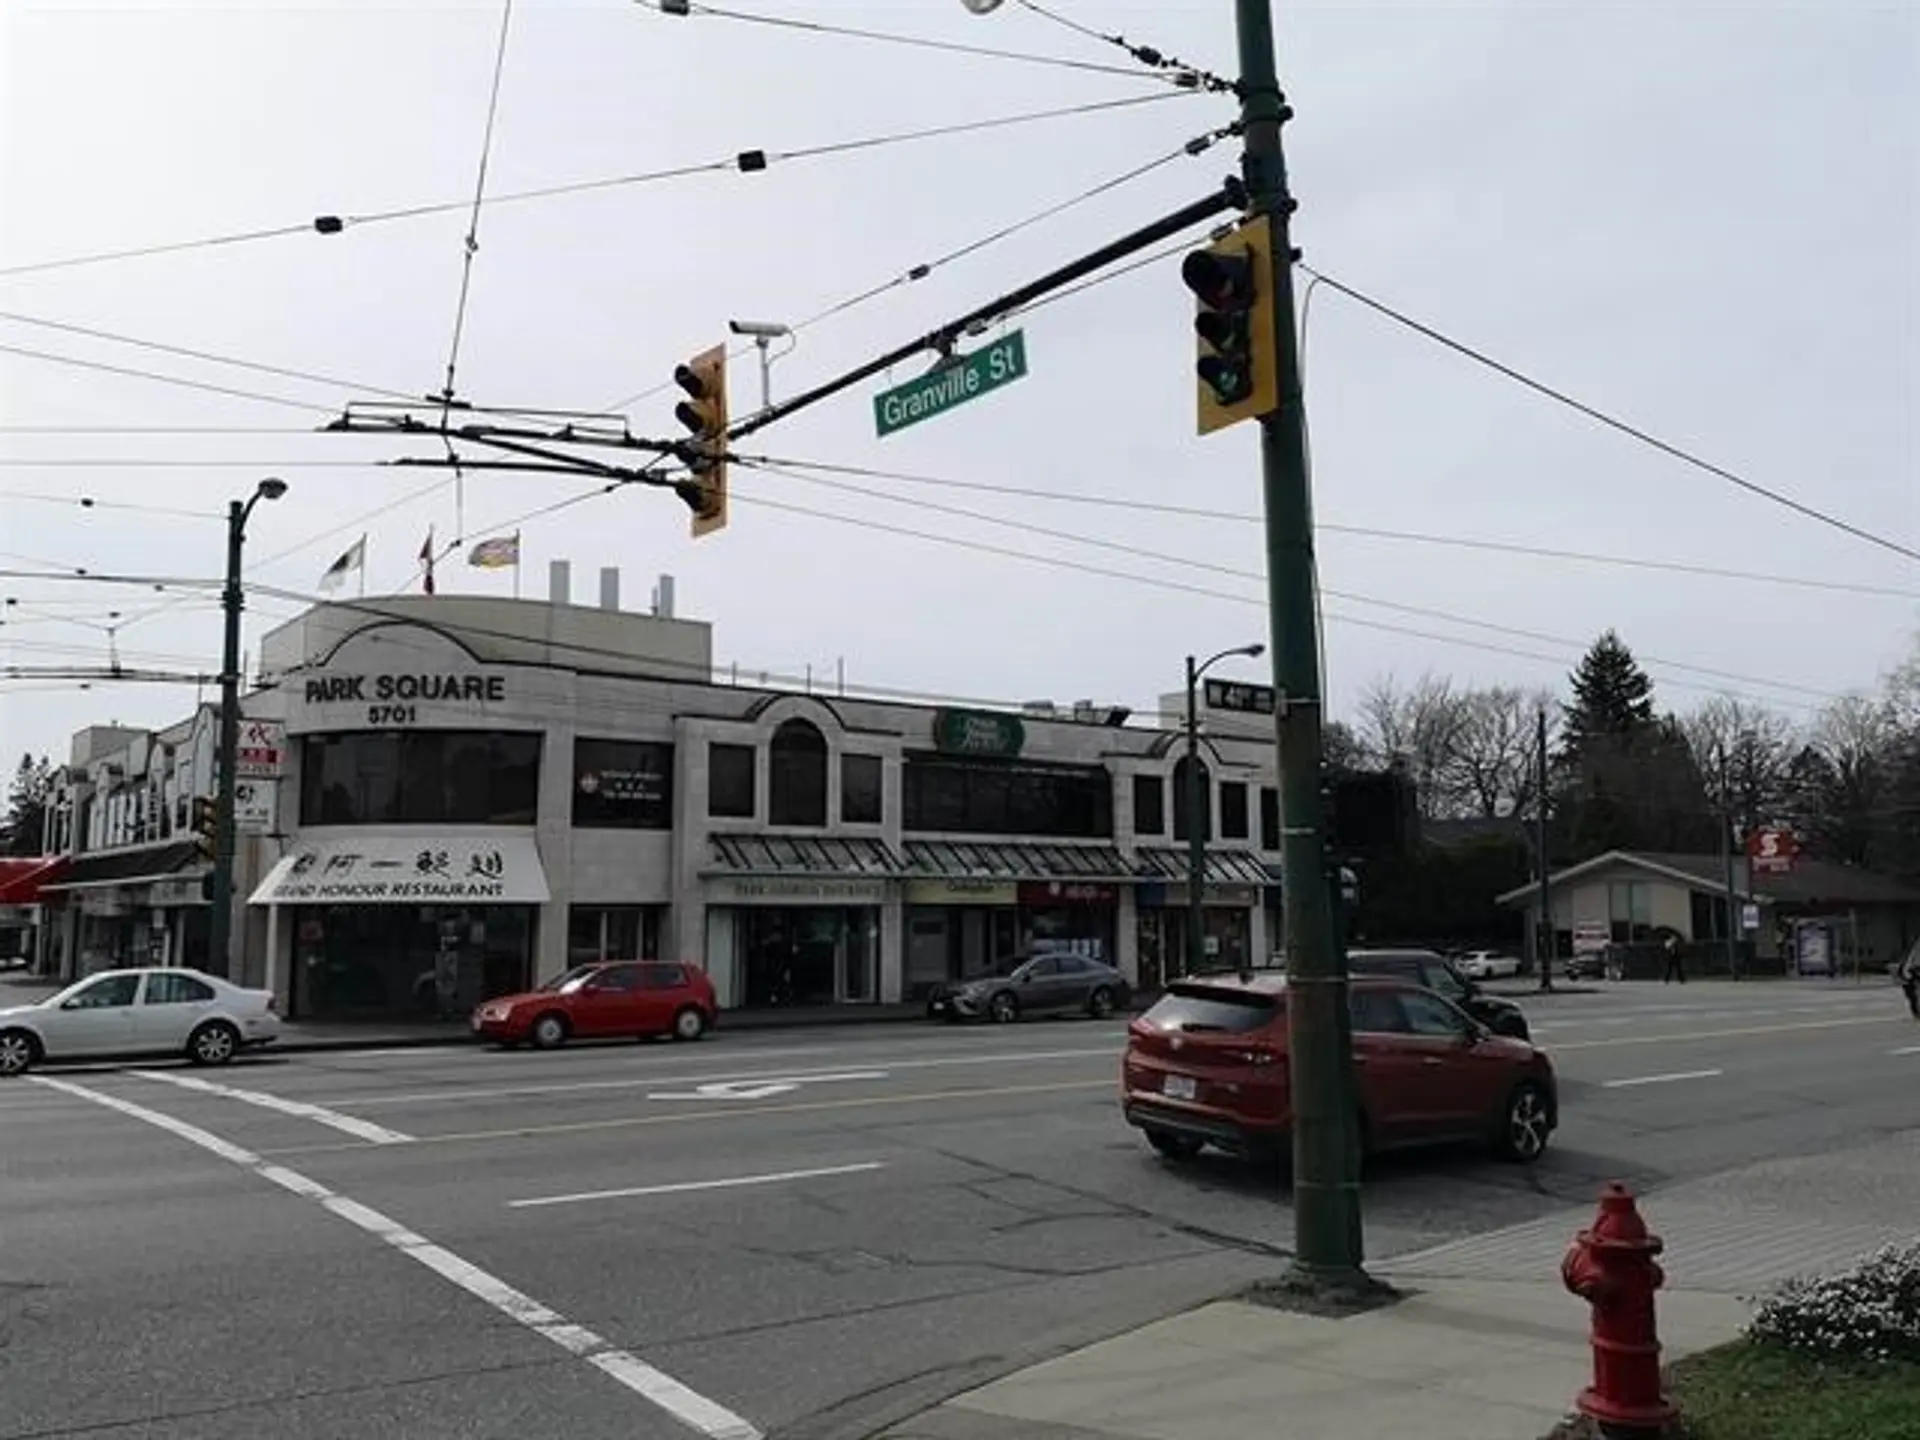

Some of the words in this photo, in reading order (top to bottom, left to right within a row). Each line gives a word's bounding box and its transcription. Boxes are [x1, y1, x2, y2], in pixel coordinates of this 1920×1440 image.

[883, 364, 980, 426] Granville
[989, 345, 1016, 380] St
[305, 676, 366, 704] PARK
[375, 674, 505, 701] SQUARE
[368, 704, 416, 724] 5701
[391, 882, 504, 897] RESTAURANT
